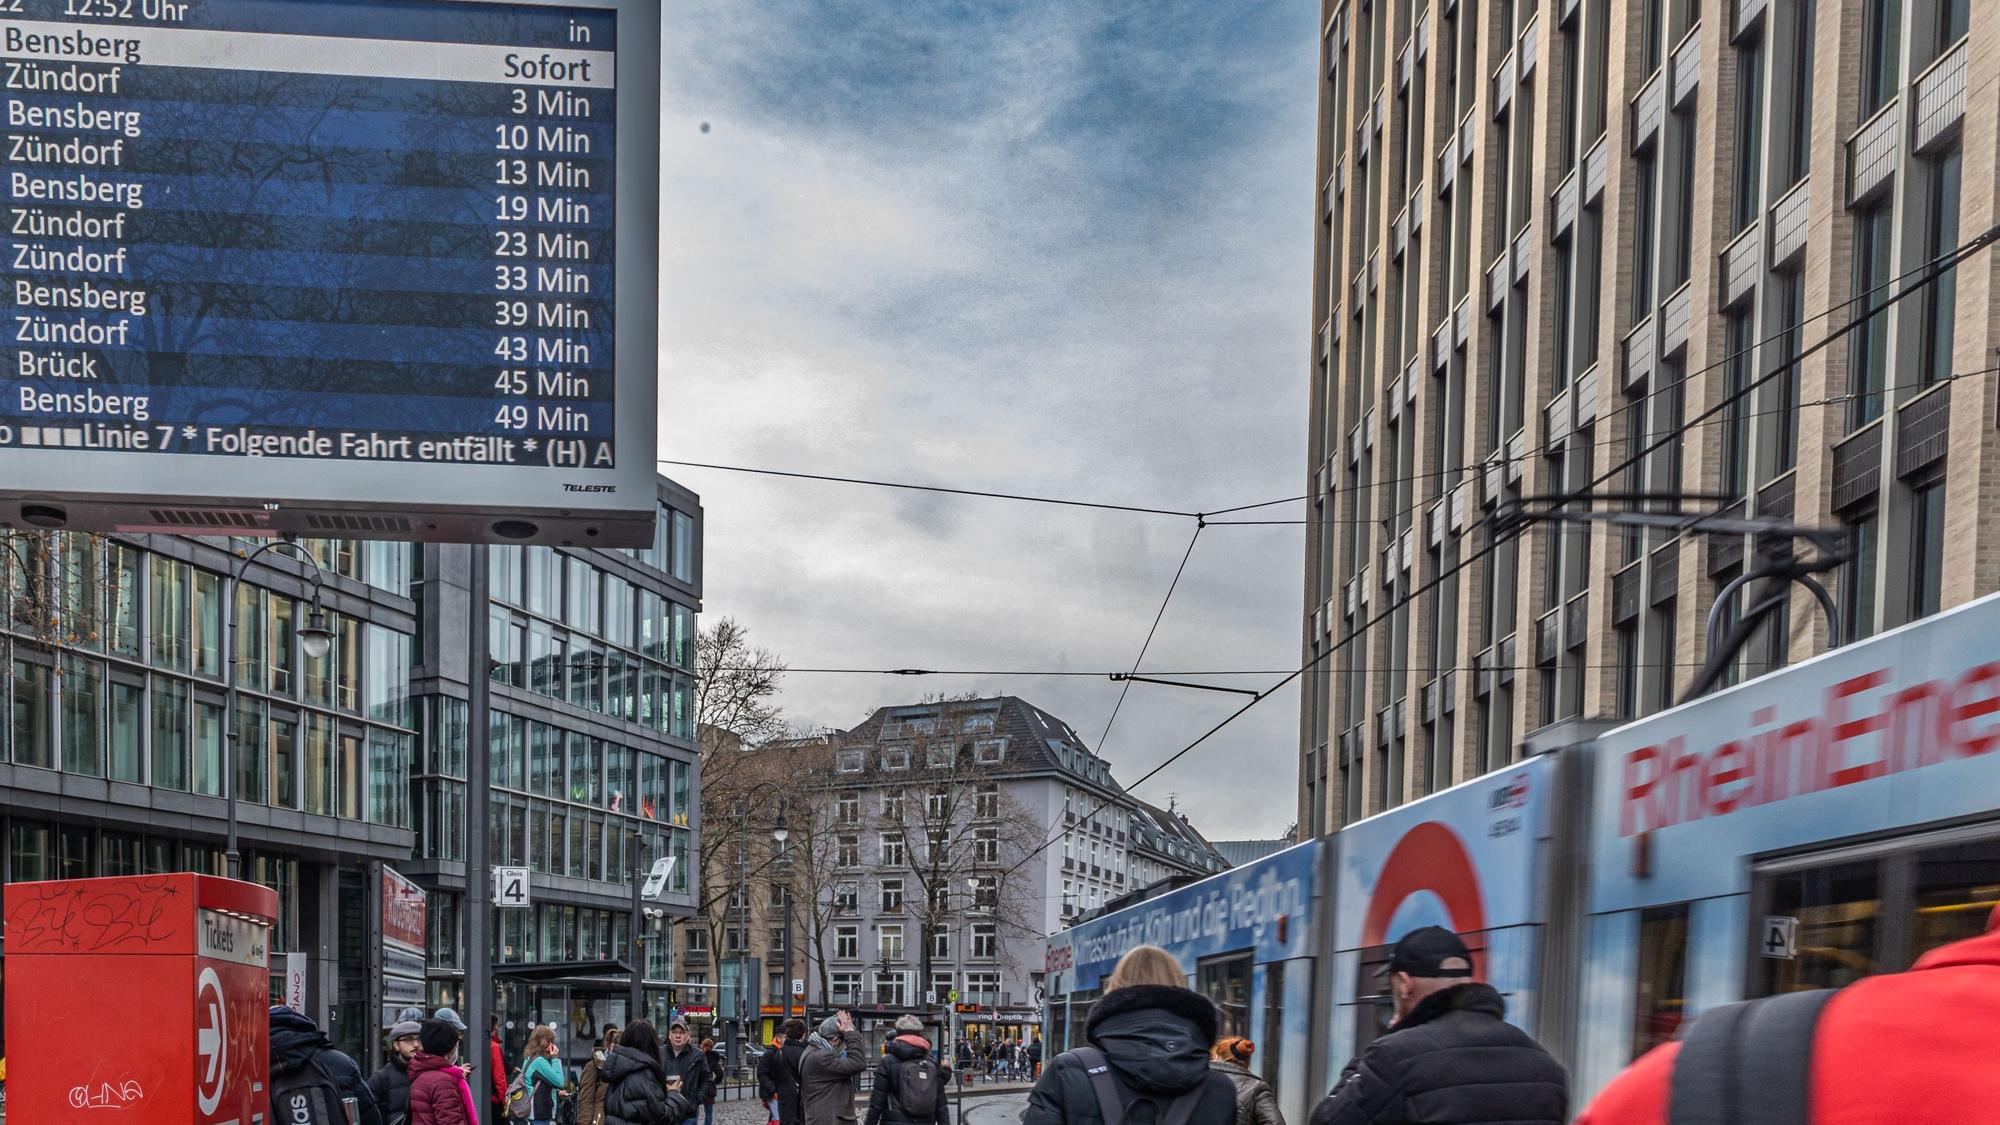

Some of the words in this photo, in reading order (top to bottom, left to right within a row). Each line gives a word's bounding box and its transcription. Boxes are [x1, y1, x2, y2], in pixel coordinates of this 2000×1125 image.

[64, 0, 133, 19] 12:52
[143, 0, 188, 21] Uhr
[569, 19, 591, 43] in
[6, 27, 141, 64] Bensberg
[504, 53, 591, 82] Sofort
[5, 62, 121, 94] Zündorf
[512, 89, 528, 114] 3
[538, 90, 590, 117] Min
[8, 99, 141, 137] Bensberg
[496, 124, 528, 151] 10
[538, 126, 590, 154] Min
[8, 136, 123, 166] Zündorf
[496, 160, 528, 185] 13
[538, 161, 590, 188] Min
[11, 173, 144, 209] Bensberg
[496, 195, 528, 221] 19
[538, 197, 590, 224] Min
[11, 208, 126, 239] Zündorf
[495, 231, 528, 257] 23
[538, 233, 590, 260] Min
[13, 244, 127, 274] Zündorf
[495, 266, 528, 291] 33
[538, 267, 590, 294] Min
[15, 280, 147, 316] Bensberg
[495, 301, 528, 326] 39
[538, 302, 590, 329] Min
[16, 316, 129, 346] Zündorf
[495, 336, 528, 361] 43
[538, 338, 590, 364] Min
[18, 350, 98, 378] Brück
[495, 371, 528, 395] 45
[538, 372, 590, 397] Min
[19, 386, 150, 421] Bensberg
[495, 405, 528, 430] 49
[538, 406, 590, 432] Min
[84, 423, 150, 449] Linie
[155, 425, 175, 450] 7
[207, 427, 333, 458] Folgende
[340, 432, 412, 458] Fahrt
[418, 436, 516, 463] entfällt
[546, 438, 588, 468] (H)
[593, 441, 613, 466] A
[562, 483, 617, 493] TELESTE
[504, 878, 525, 903] 4
[205, 919, 234, 953] Tickets
[1145, 905, 1173, 946] Köln
[1172, 895, 1200, 944] und
[1202, 888, 1227, 937] die
[795, 983, 802, 992] B
[929, 994, 935, 1002] B
[978, 1013, 993, 1021] ring
